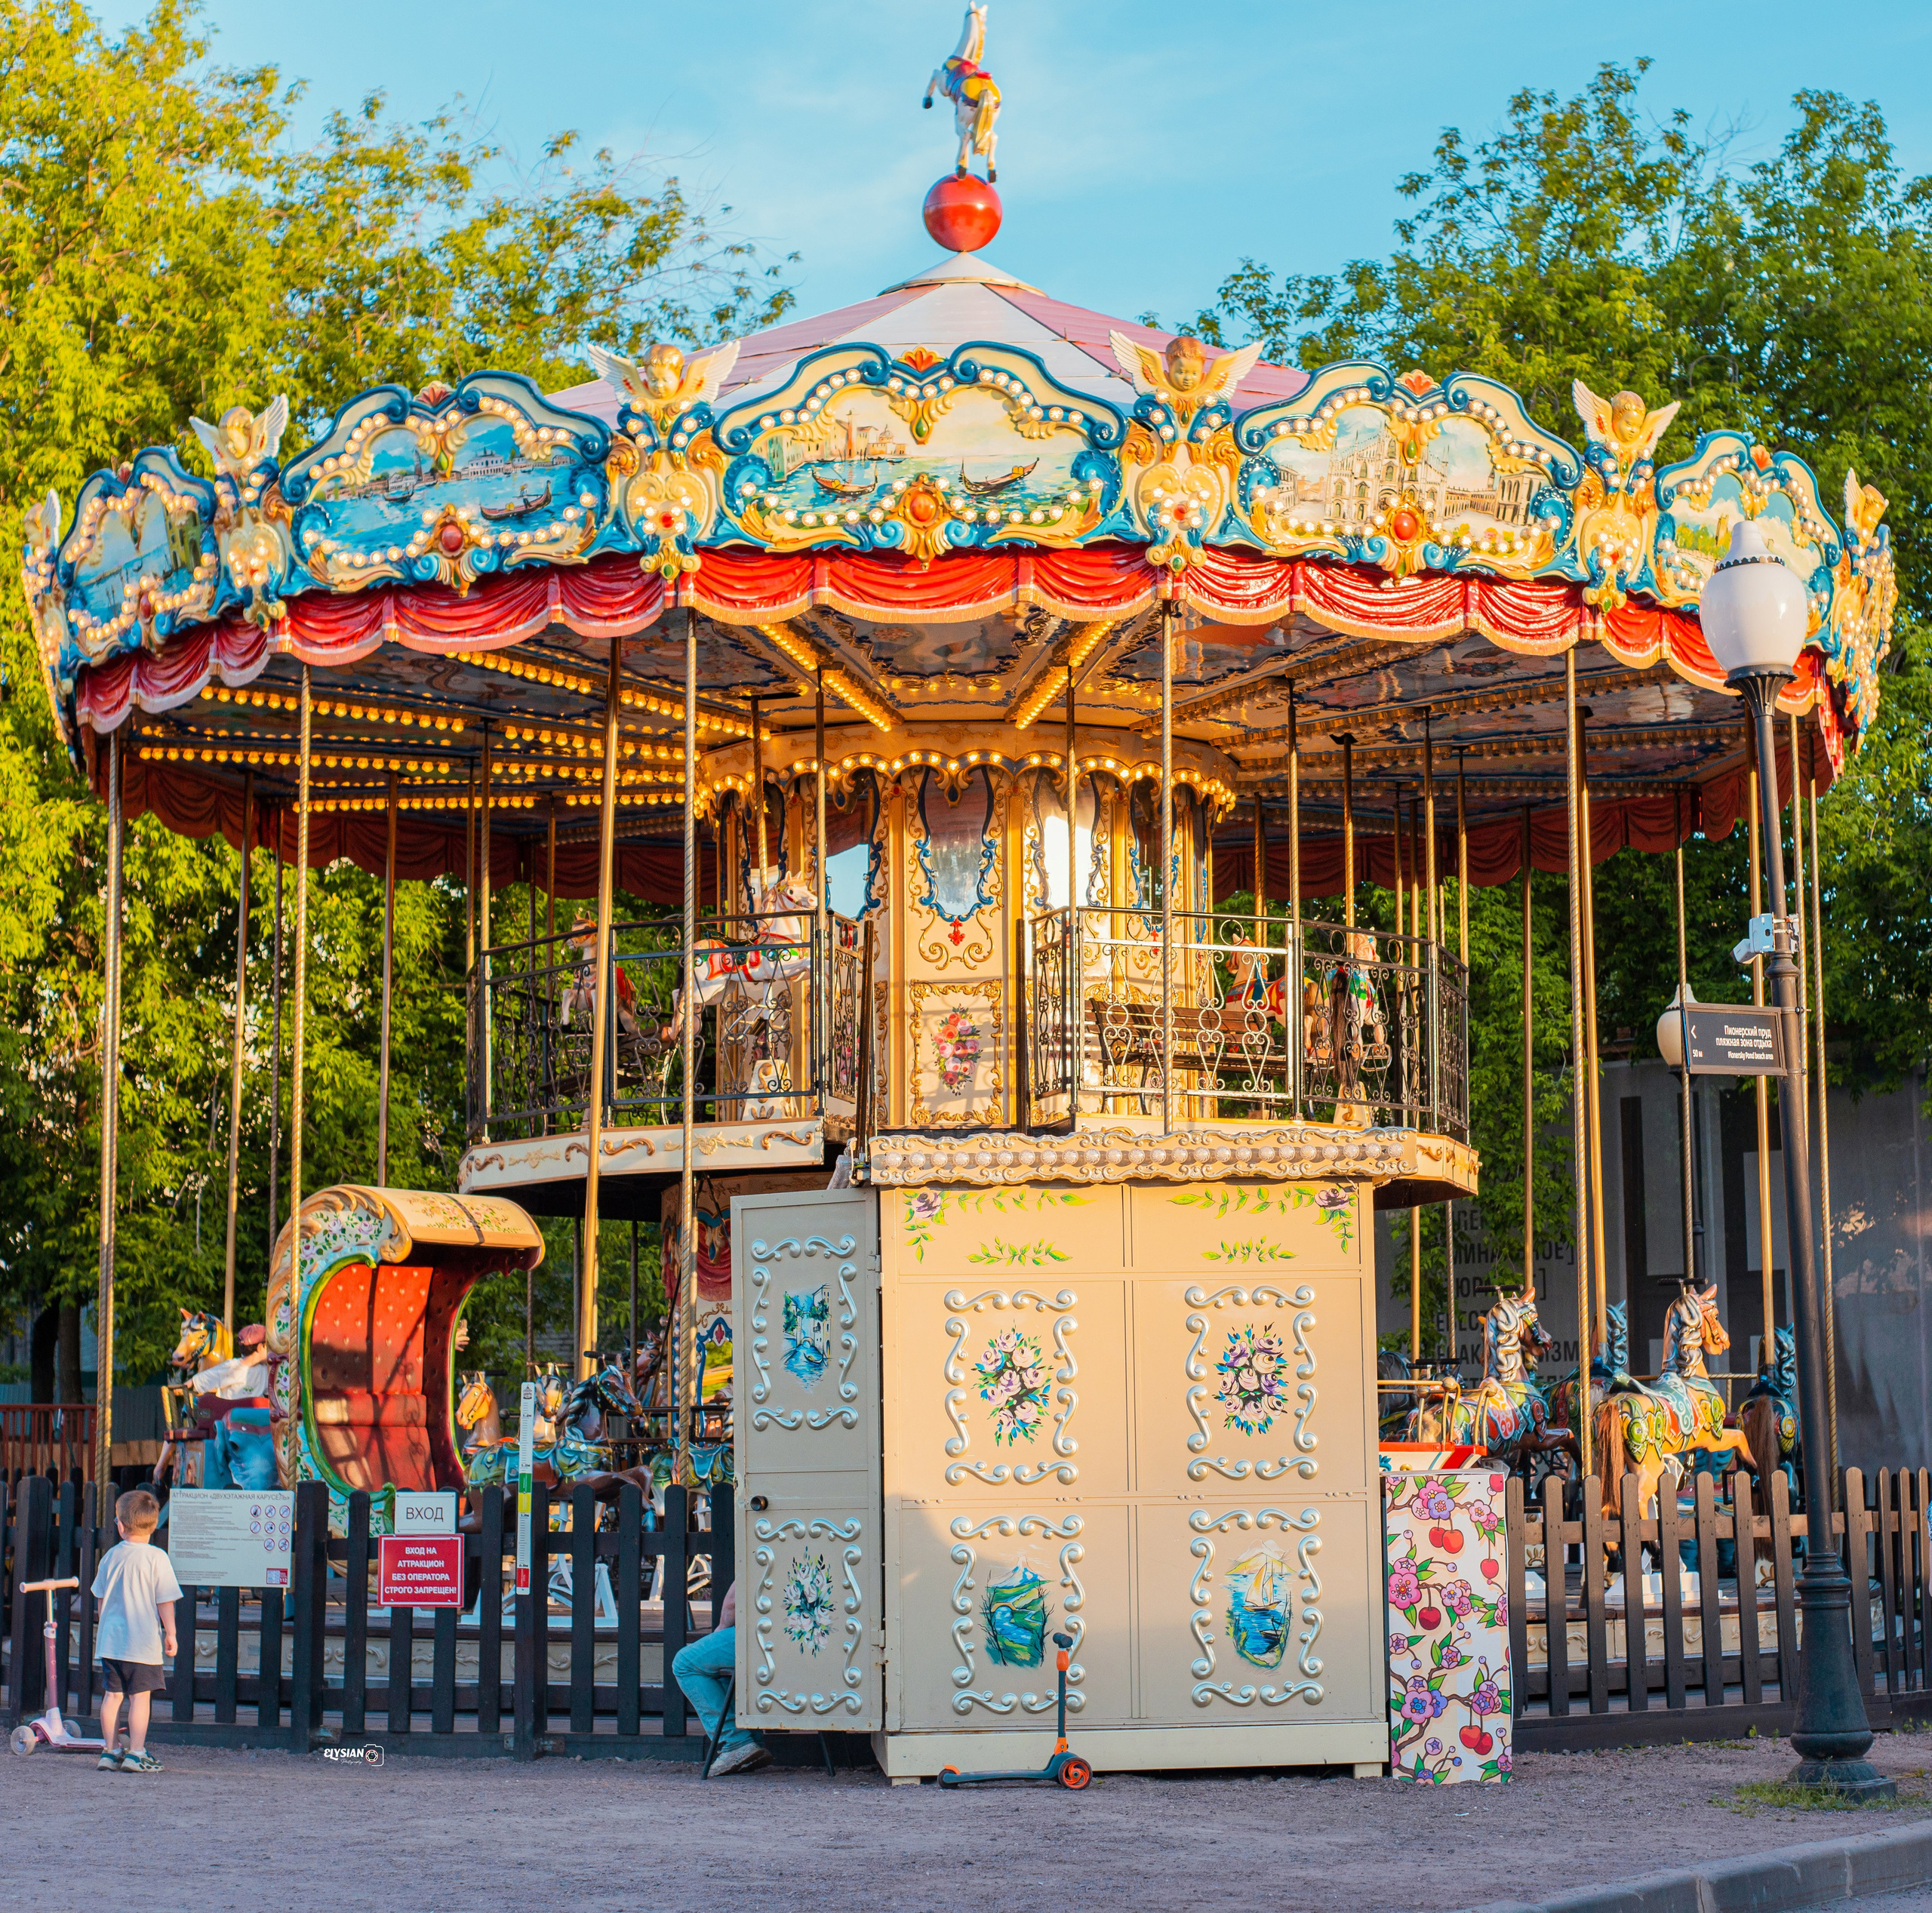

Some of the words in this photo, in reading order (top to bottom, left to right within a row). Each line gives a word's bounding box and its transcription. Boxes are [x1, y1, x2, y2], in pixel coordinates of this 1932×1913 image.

[1724, 1025, 1758, 1037] Пионерский
[1758, 1028, 1772, 1039] пруд
[1715, 1038, 1740, 1047] пляжная
[1740, 1038, 1753, 1047] зона
[1753, 1039, 1773, 1049] отдыха
[1692, 1049, 1698, 1057] 50
[1728, 1050, 1746, 1060] Pionersky
[1746, 1051, 1755, 1060] Pond
[1755, 1051, 1765, 1060] beach
[405, 1507, 444, 1522] ВХОД
[405, 1547, 425, 1555] ВХОД
[397, 1560, 445, 1569] АТТРАКЦИОН
[414, 1586, 457, 1595] ЗАПРЕЩЕН!
